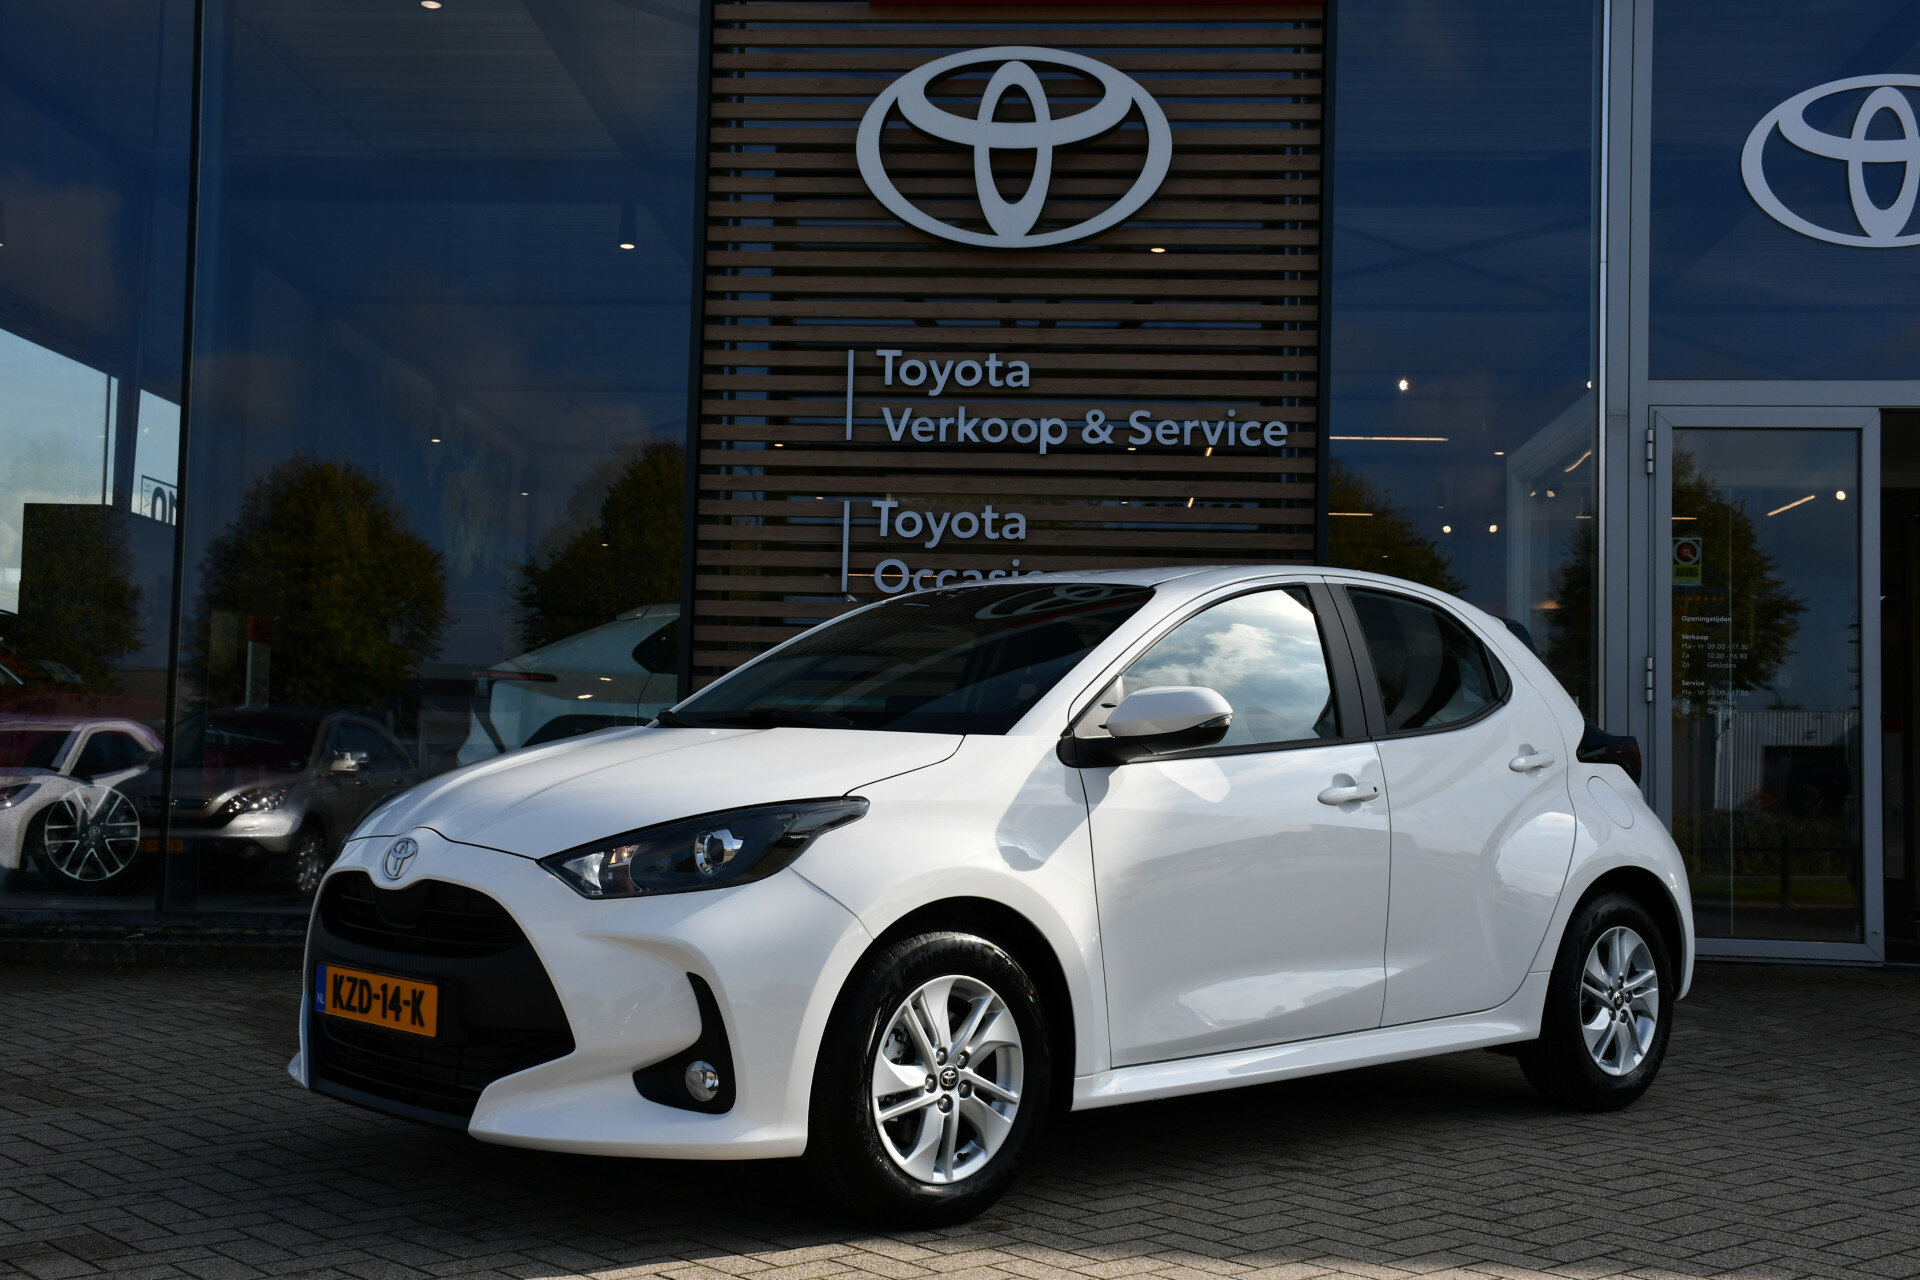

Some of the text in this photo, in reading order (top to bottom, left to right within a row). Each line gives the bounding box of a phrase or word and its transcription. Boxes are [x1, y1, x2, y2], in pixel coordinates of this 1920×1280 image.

[876, 349, 1030, 396] Toyota
[882, 405, 1288, 454] Verkoop & Service
[872, 501, 1026, 548] Toyota
[1675, 567, 1698, 577] BOVAG
[316, 974, 425, 1027] NL KZD-14-K
